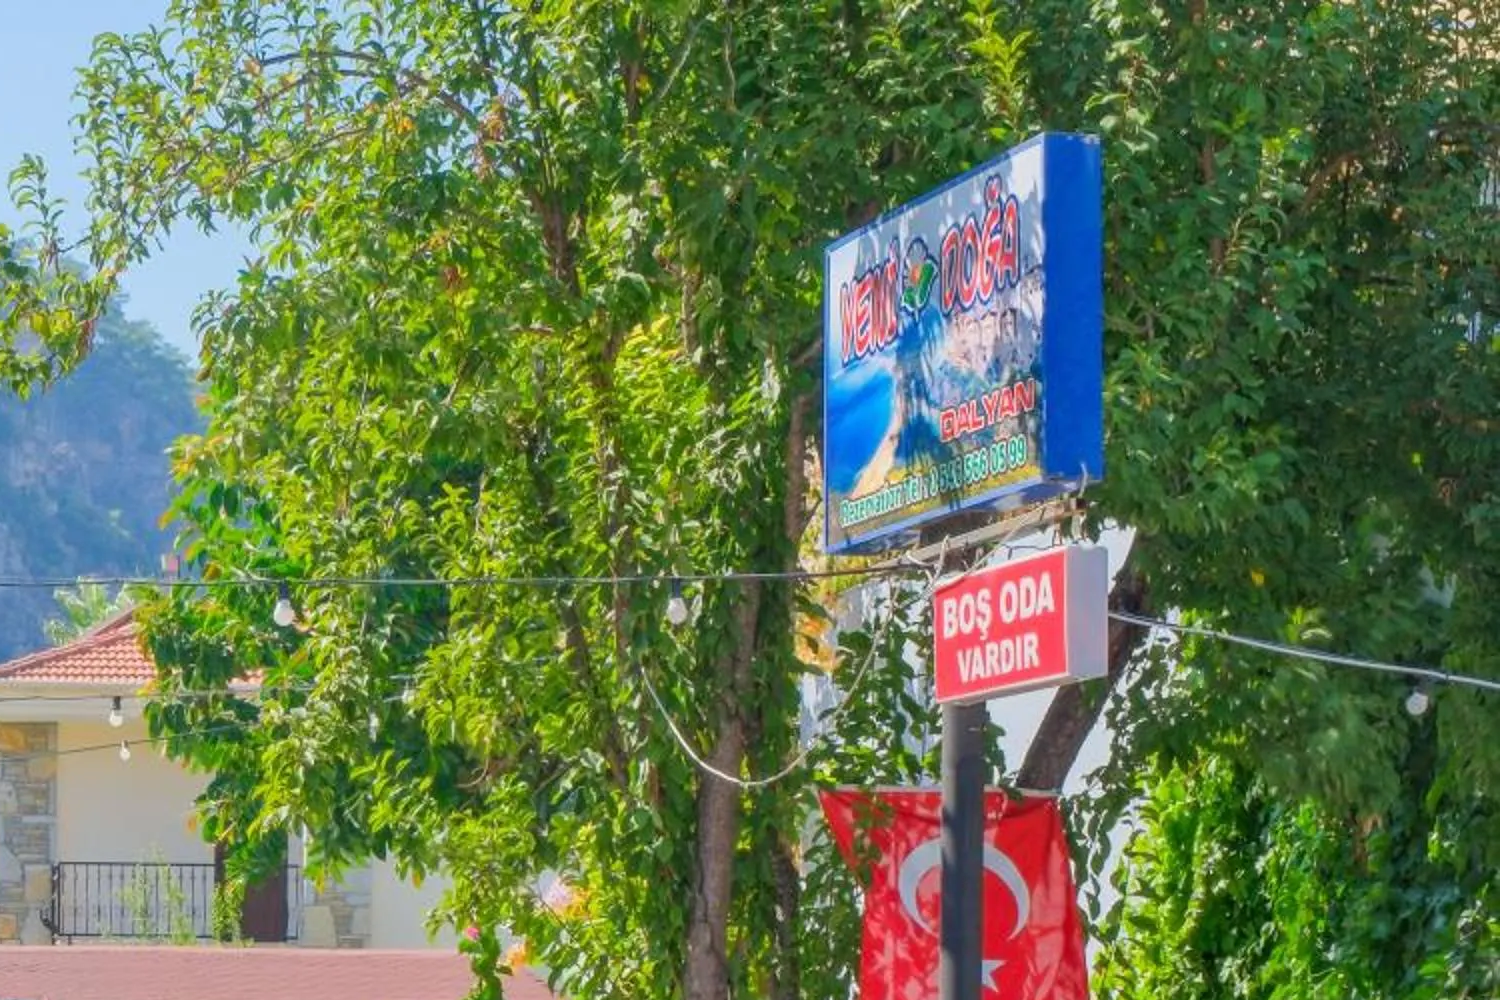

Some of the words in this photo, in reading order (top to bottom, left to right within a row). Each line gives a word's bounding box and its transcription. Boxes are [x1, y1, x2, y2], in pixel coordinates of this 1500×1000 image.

[941, 174, 1020, 316] DOĞA
[940, 378, 1035, 442] DALYAN
[1008, 433, 1027, 469] 99
[942, 588, 993, 641] BOŞ
[999, 572, 1055, 624] ODA
[957, 632, 1040, 684] VARDIR
